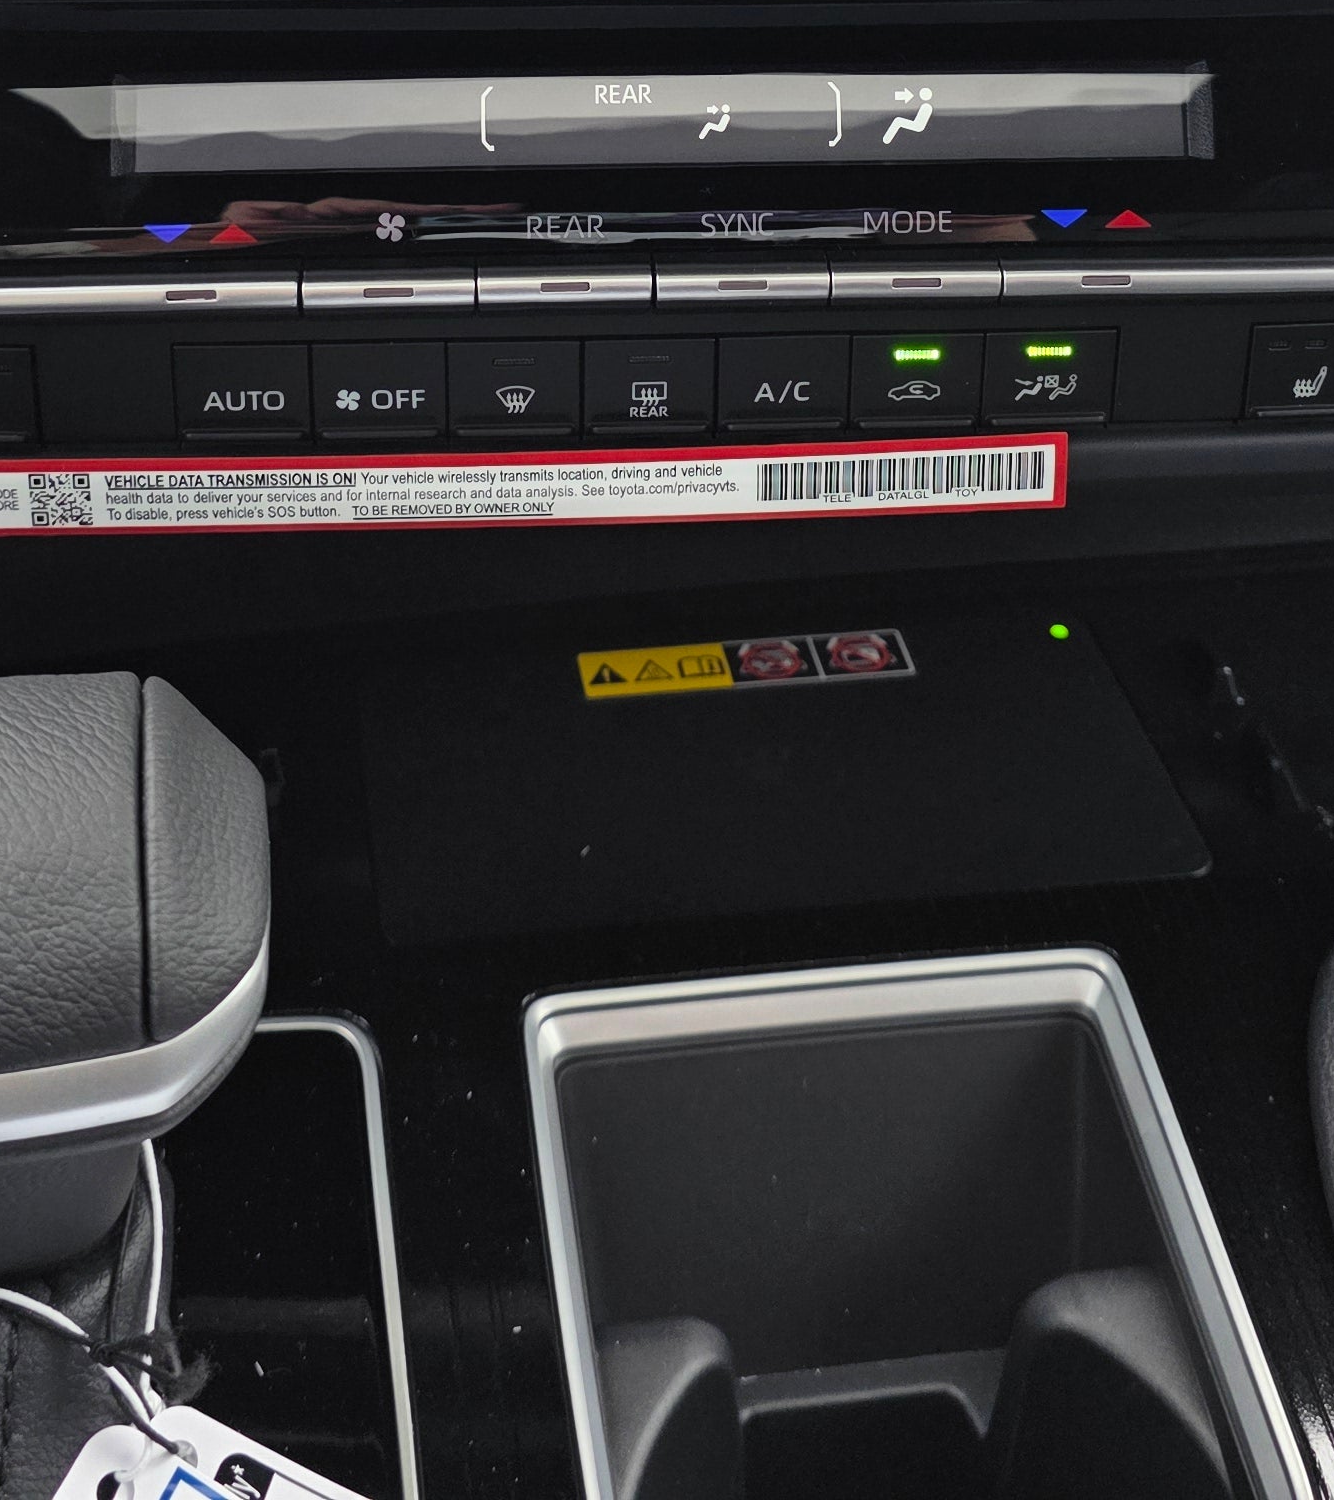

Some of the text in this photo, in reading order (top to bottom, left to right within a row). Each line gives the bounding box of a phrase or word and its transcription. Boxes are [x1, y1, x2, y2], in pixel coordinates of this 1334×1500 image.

[593, 83, 652, 105] REAR
[525, 213, 607, 240] REAR
[699, 211, 775, 238] SYNC
[862, 209, 954, 235] MODE
[203, 390, 285, 412] AUTO
[370, 389, 426, 410] OFF
[753, 380, 811, 404] A/C
[628, 405, 669, 418] REAR
[104, 463, 724, 488] VEHICLE DATA TRANSMISSION IS ON! Your vehicle wirelessly transmits location, driving and vehicle
[105, 480, 740, 506] health data to deliver your services and for internal research and data analysis. See toyota.com/privacyvts.
[822, 493, 852, 503] TELE
[954, 487, 979, 498] TOY
[107, 502, 555, 521] To disable, press vehicle's SOS button. TO BE REMOVED BY OWNER ONLY
